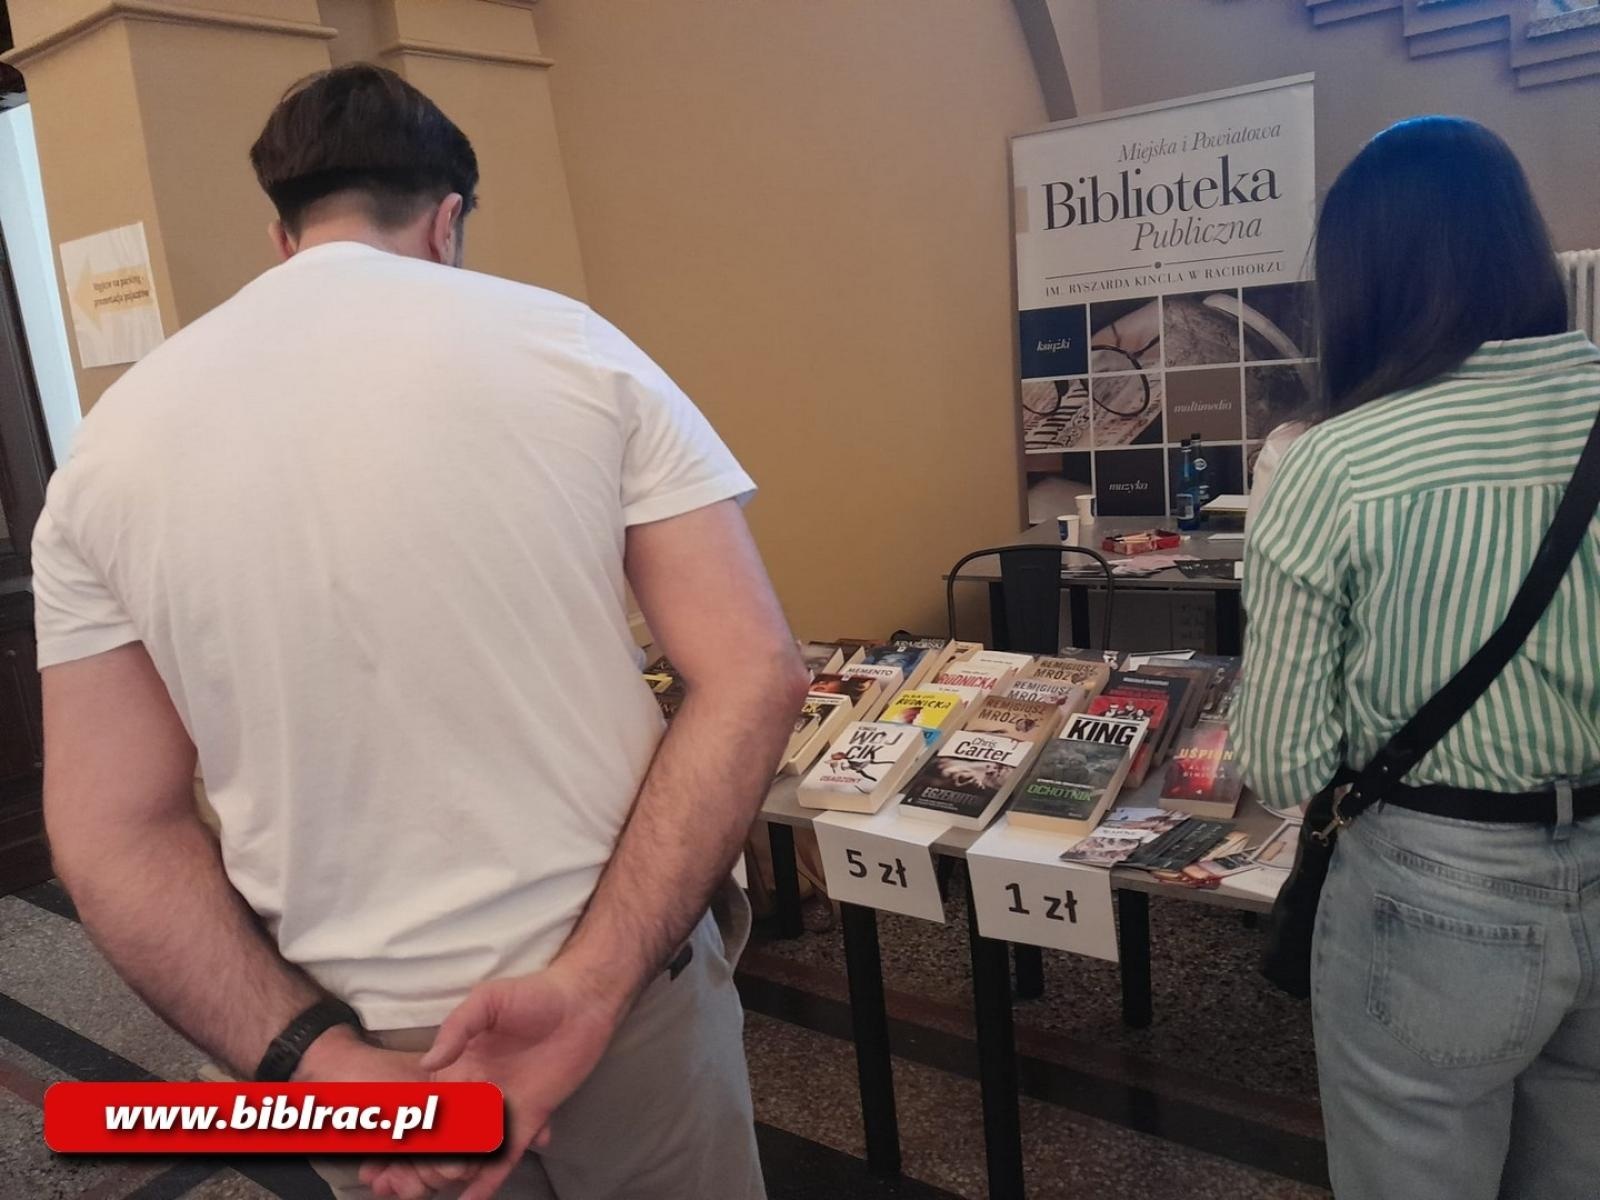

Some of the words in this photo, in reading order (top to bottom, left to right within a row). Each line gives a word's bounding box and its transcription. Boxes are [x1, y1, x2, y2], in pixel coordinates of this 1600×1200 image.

[1117, 138, 1178, 164] Miejska
[1181, 134, 1187, 152] i
[1192, 123, 1282, 151] Powiatowa
[1041, 154, 1282, 231] Biblioteka
[1131, 217, 1263, 252] Publiczna
[1069, 279, 1130, 295] RYSZARDA
[1189, 270, 1198, 280] W
[1205, 260, 1285, 279] RACIBORZU
[1174, 399, 1233, 414] multimedia
[1108, 480, 1149, 495] muzyka
[1013, 680, 1073, 696] REMIGIUSZ
[1067, 719, 1139, 745] KING
[954, 740, 1013, 762] Carter
[845, 848, 867, 878] 5
[878, 857, 908, 889] zł
[1004, 882, 1030, 915] 1
[1043, 890, 1078, 923] zł
